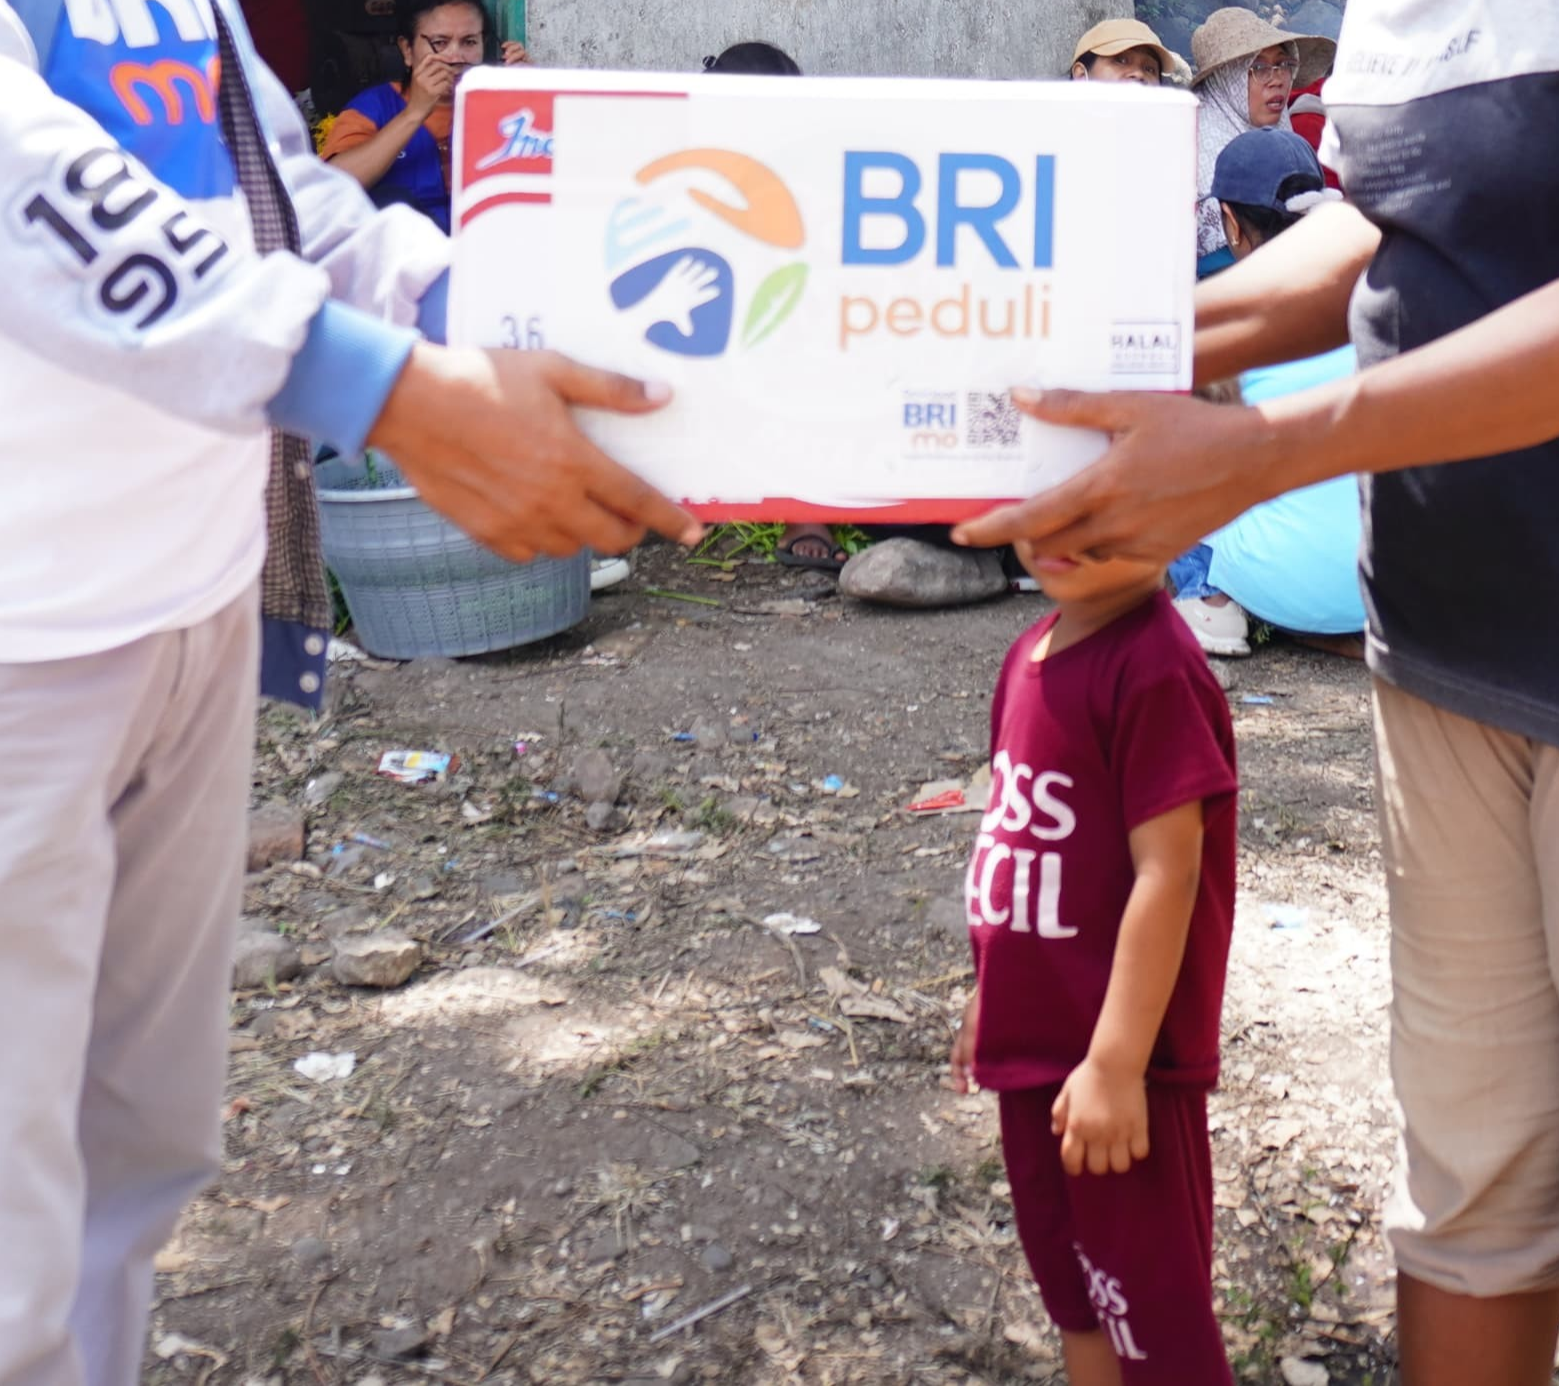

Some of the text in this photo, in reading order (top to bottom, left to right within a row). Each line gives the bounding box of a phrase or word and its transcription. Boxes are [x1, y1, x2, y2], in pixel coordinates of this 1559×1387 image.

[841, 150, 1056, 270] BRI
[838, 283, 1052, 352] peduli
[1110, 334, 1178, 350] HALAL
[903, 403, 957, 428] BRI
[911, 432, 958, 451] mo
